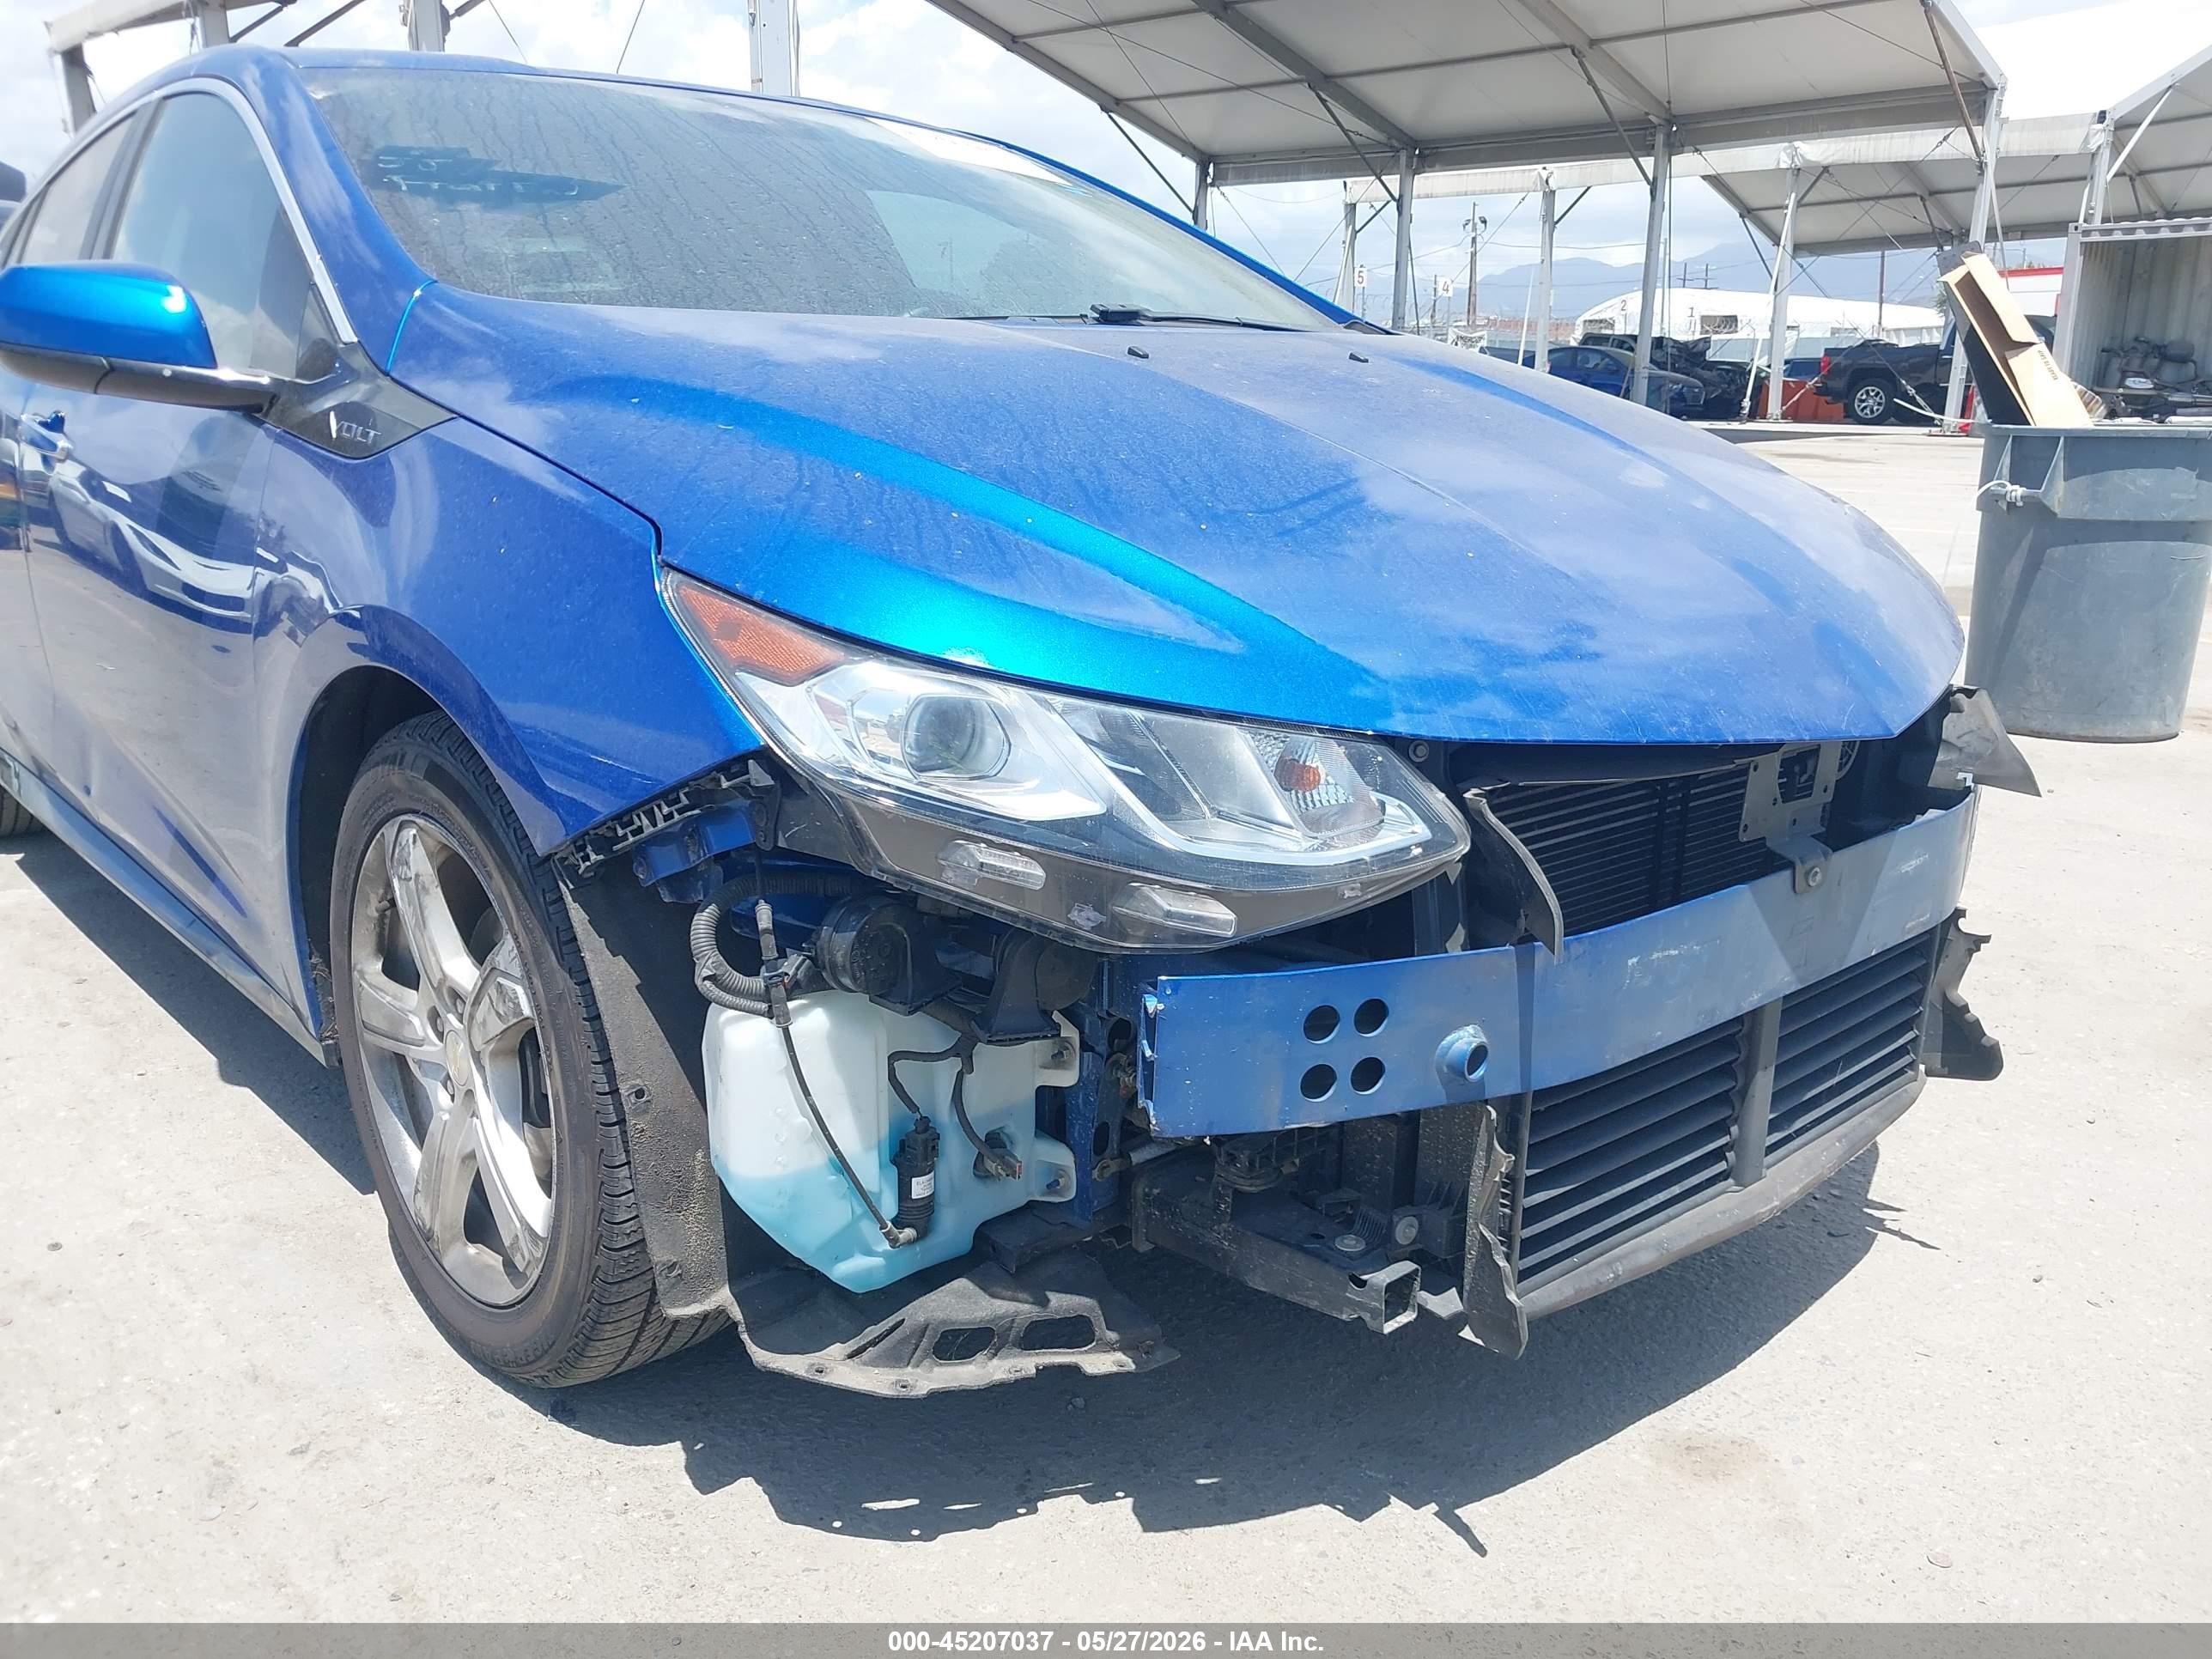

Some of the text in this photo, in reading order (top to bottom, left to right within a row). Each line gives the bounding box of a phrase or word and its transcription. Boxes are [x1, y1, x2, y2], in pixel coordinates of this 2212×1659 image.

[1357, 270, 1364, 284] 5
[1442, 281, 1449, 294] 4
[1620, 299, 1627, 311] 2
[1686, 307, 1695, 318] 1
[329, 410, 382, 444] VOLT
